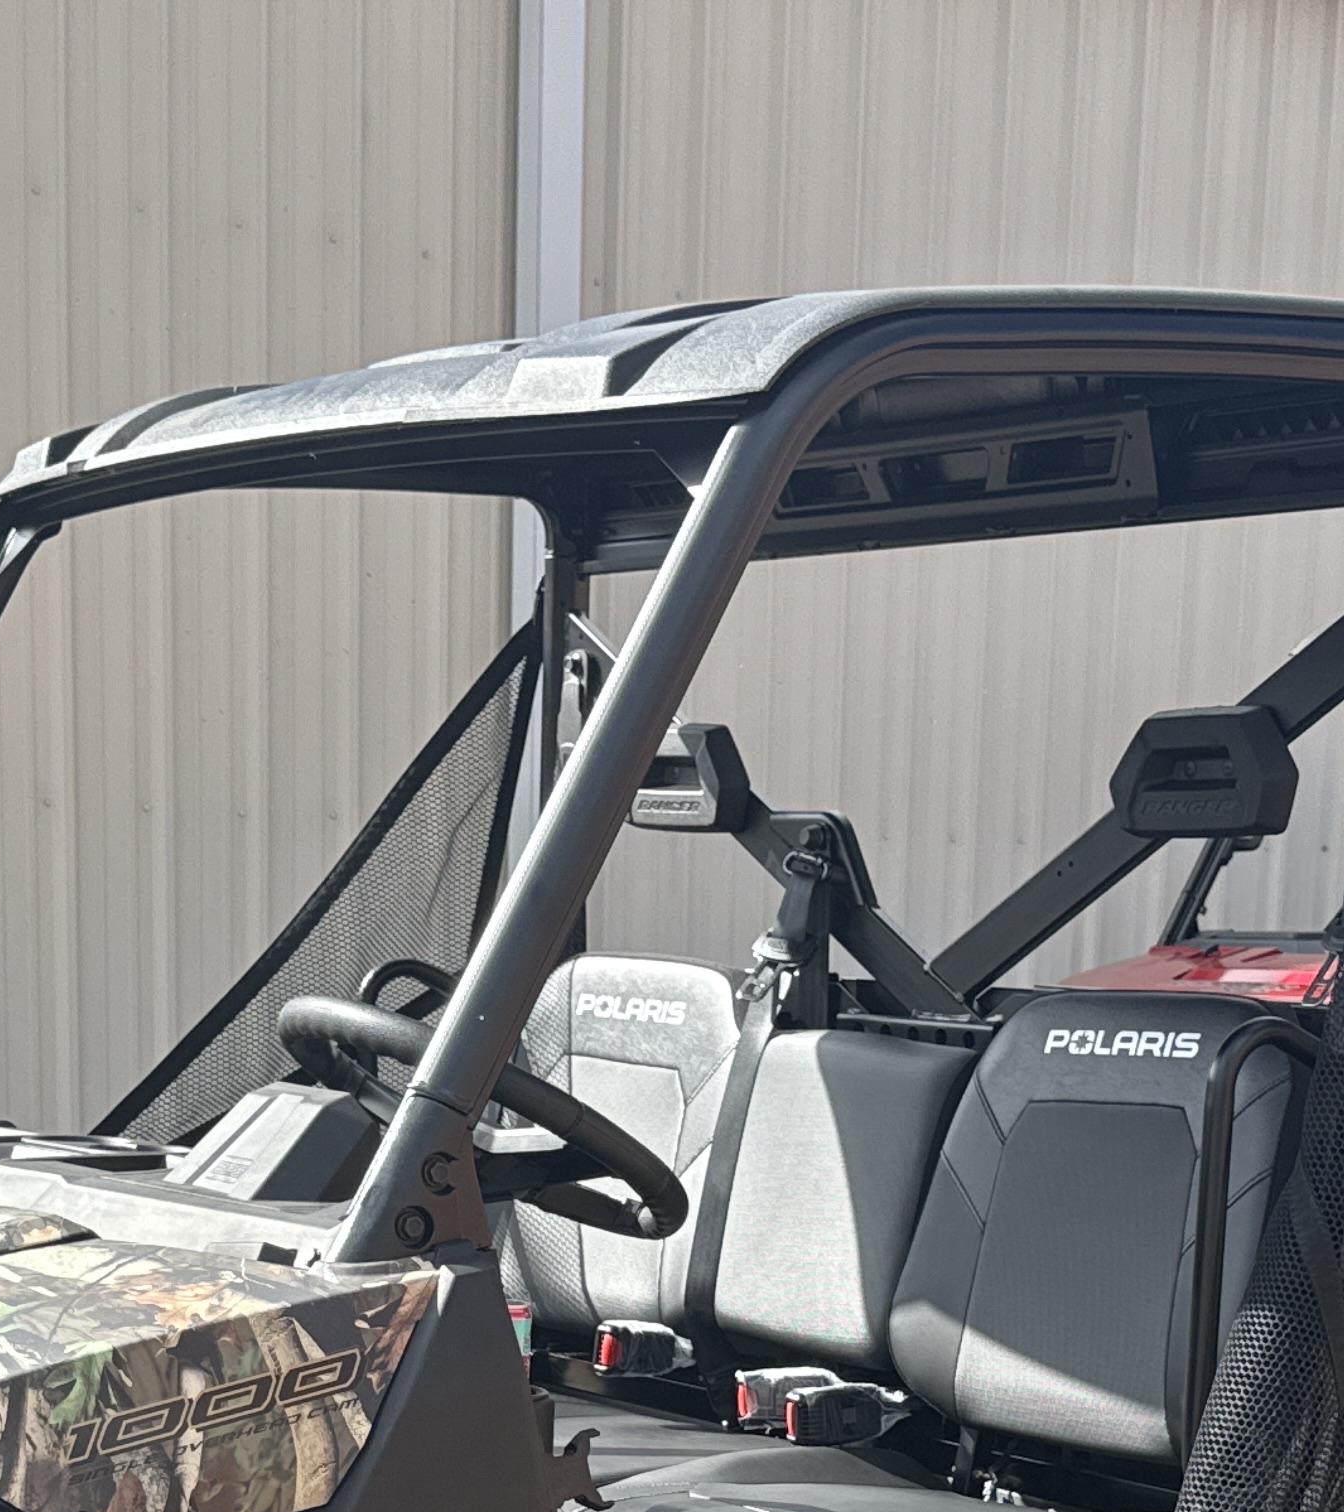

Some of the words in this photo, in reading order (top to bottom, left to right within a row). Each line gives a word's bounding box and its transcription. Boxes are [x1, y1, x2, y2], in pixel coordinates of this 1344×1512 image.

[637, 799, 701, 812] RANGER
[1140, 798, 1236, 816] RANGER
[575, 993, 687, 1026] POLARIS
[1043, 1029, 1202, 1059] POLARIS
[65, 1348, 365, 1466] 1000
[68, 1455, 164, 1487] SINGLE
[173, 1411, 303, 1457] OVERHEAD
[305, 1396, 360, 1429] CAM
